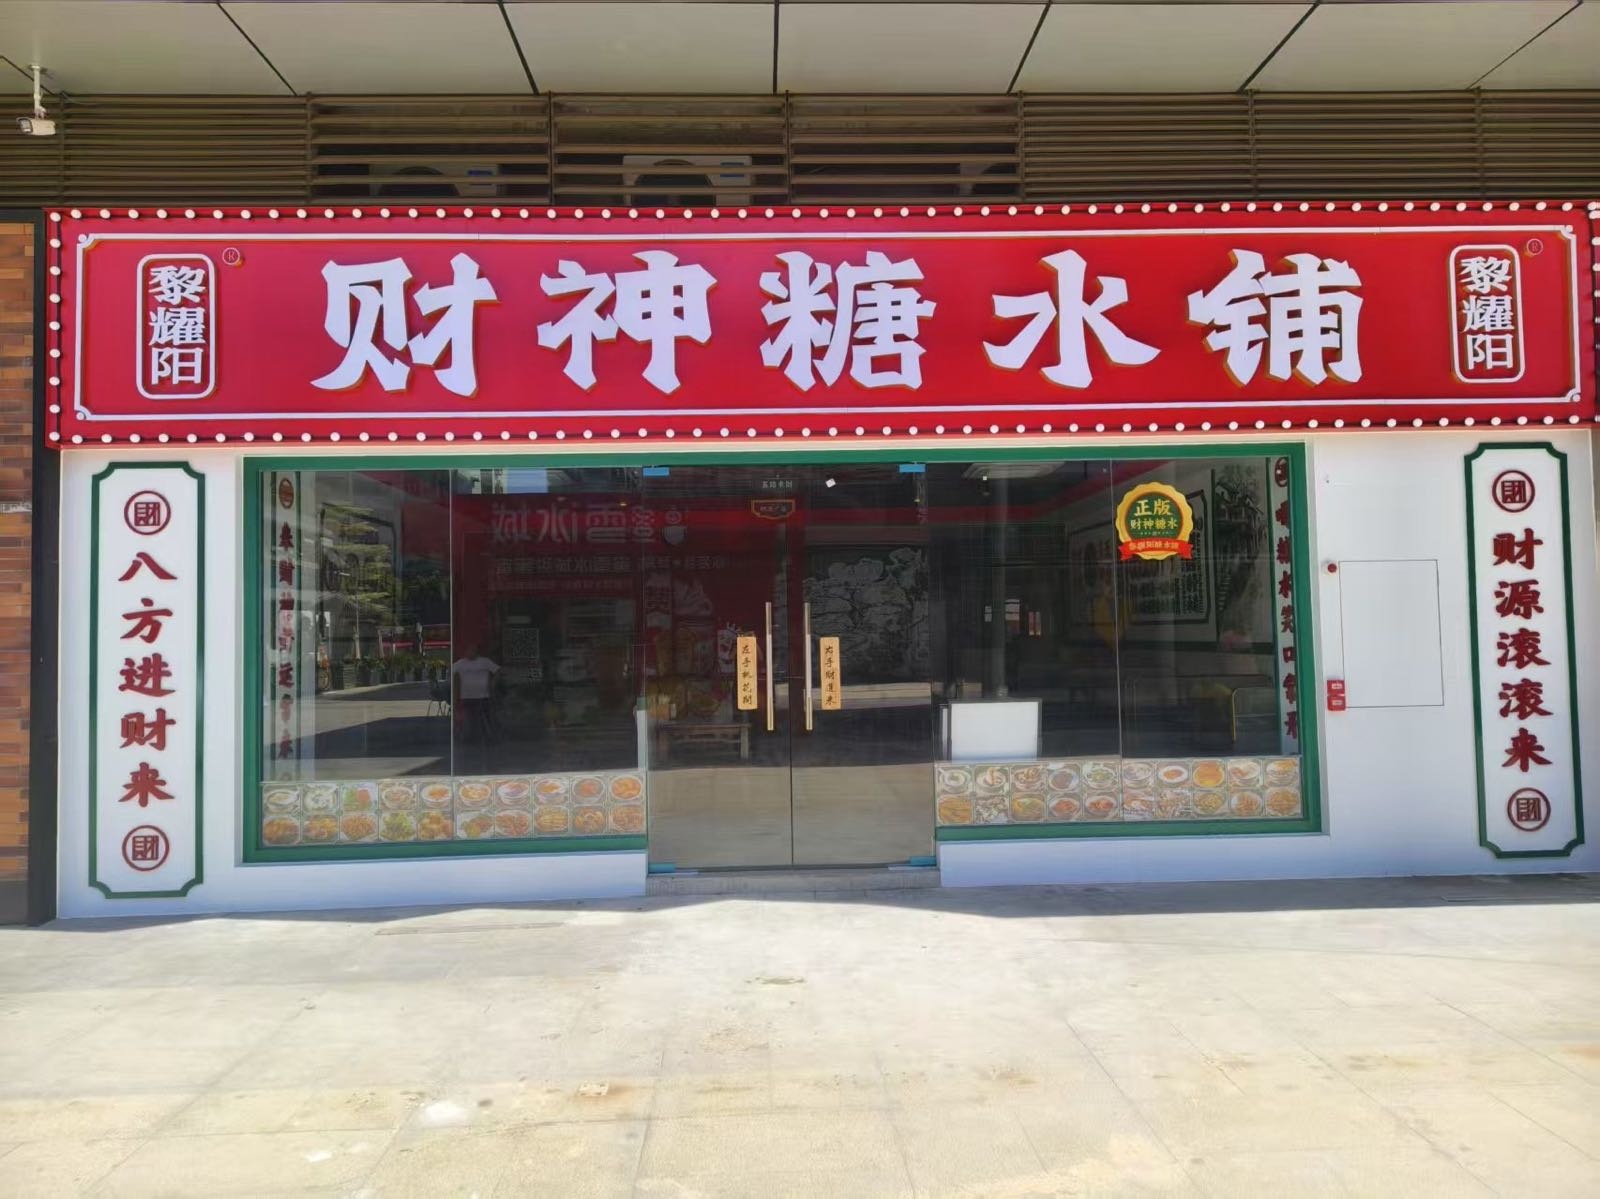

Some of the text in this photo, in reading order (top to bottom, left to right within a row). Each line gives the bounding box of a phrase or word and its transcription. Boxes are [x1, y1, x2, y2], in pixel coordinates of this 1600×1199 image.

[148, 265, 207, 386] 黎耀阳
[311, 248, 1364, 398] 财神糖水铺
[1459, 255, 1515, 371] 黎耀阳
[1130, 517, 1178, 530] 财神糖水
[1134, 498, 1173, 516] 正版
[118, 551, 178, 808] 八方进财来
[1492, 528, 1554, 773] 财源滚滚来
